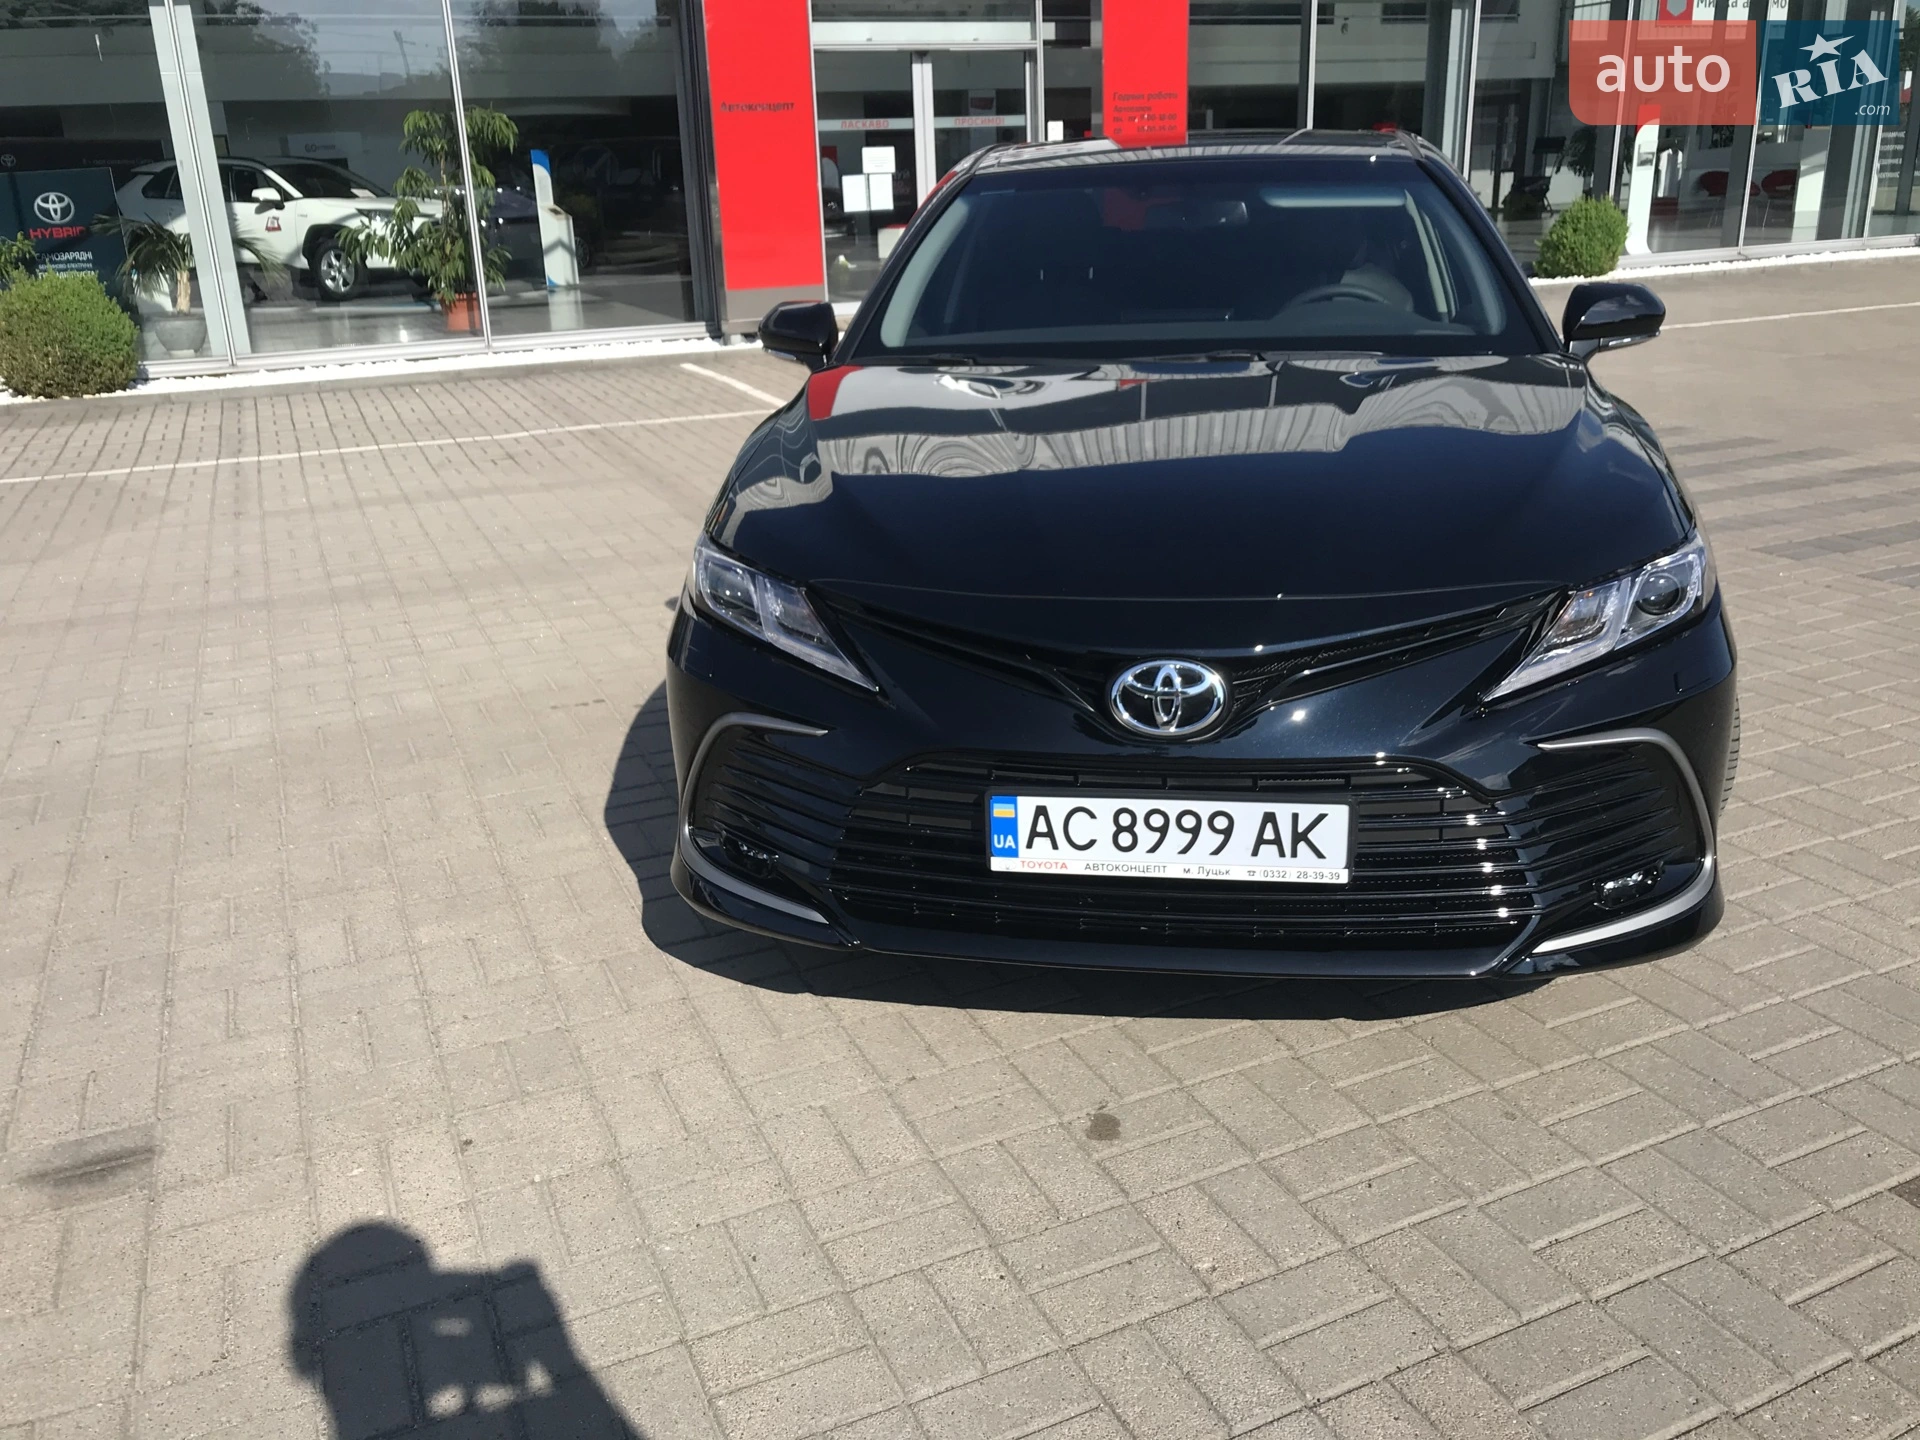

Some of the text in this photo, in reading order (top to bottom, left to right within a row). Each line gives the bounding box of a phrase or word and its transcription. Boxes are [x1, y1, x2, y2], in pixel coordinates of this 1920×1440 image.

[841, 120, 889, 129] ЛАСКАВО
[954, 117, 1005, 126] ПРОСИМО!
[1025, 804, 1329, 859] AC 8999 AK
[993, 834, 1016, 849] UA
[1020, 860, 1069, 871] TOYOTA
[1084, 863, 1168, 874] АВТОКОНЦЕПТ
[1197, 867, 1231, 876] Луцьк
[1296, 871, 1341, 881] 28-39-39
